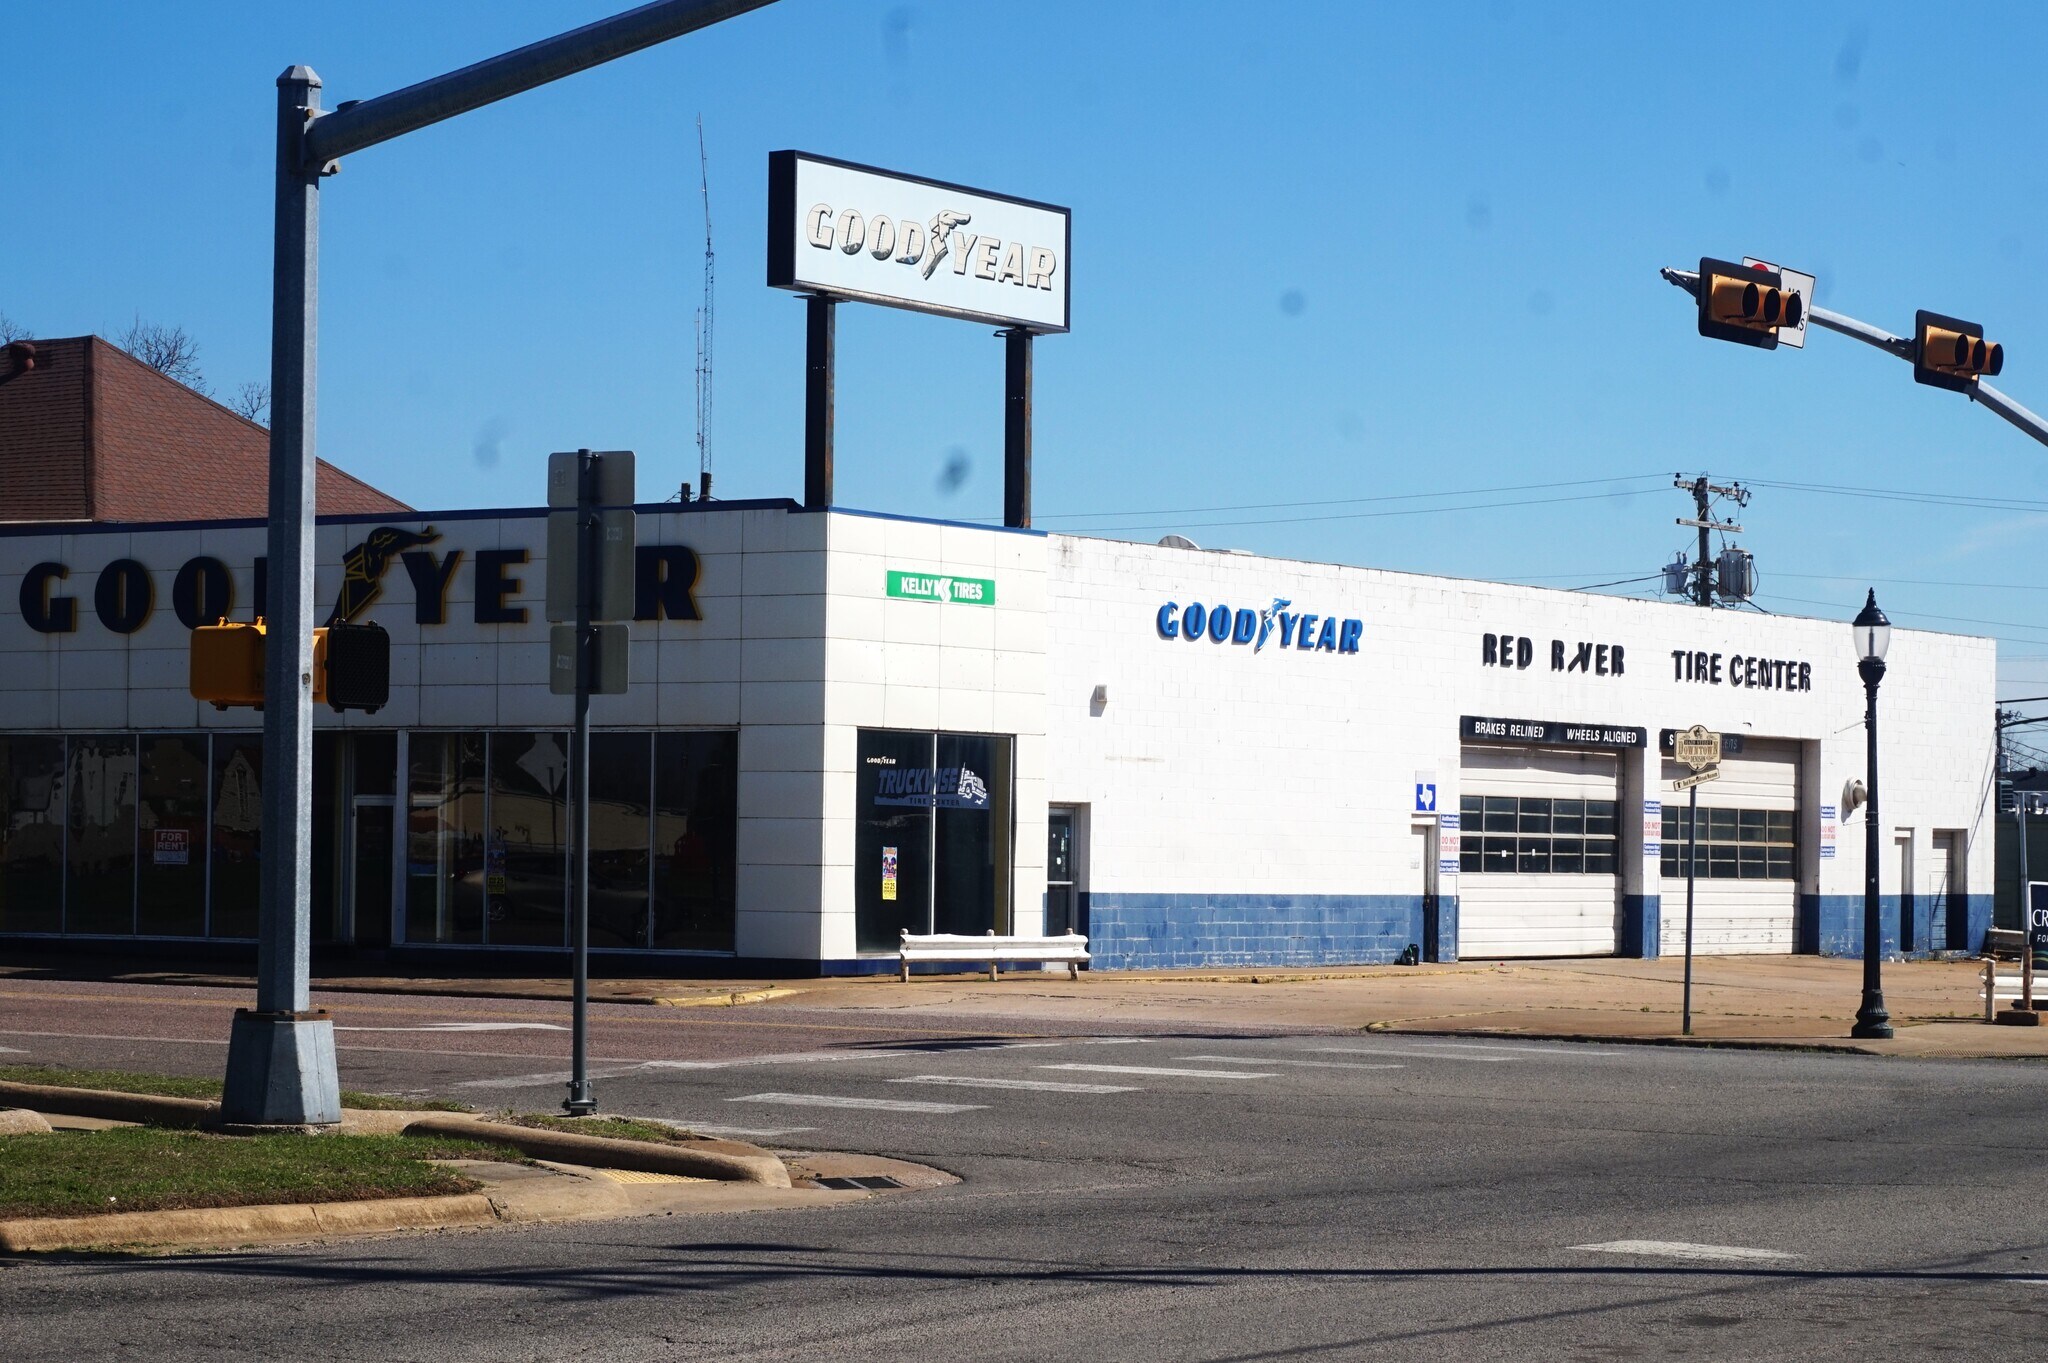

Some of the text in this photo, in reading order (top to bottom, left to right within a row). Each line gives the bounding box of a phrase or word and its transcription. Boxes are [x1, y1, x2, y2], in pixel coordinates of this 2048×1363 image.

[807, 203, 1056, 291] GOODYEAR
[19, 545, 703, 634] GOOYER
[901, 577, 933, 595] KELLY
[953, 582, 983, 600] TIRES
[1156, 598, 1363, 654] GOODYEAR
[1483, 633, 1532, 669] RED
[1671, 650, 1811, 691] TIRE CENTER
[1475, 722, 1637, 743] BRAKES RELINED WHEELS ALIGNED
[1678, 741, 1718, 755] DOWNTOWN
[867, 756, 896, 765] GOODYEAR
[879, 768, 958, 794] TRUCKWISE
[157, 841, 186, 850] RENT
[160, 832, 182, 841] FOR
[1442, 836, 1459, 845] DO NOT
